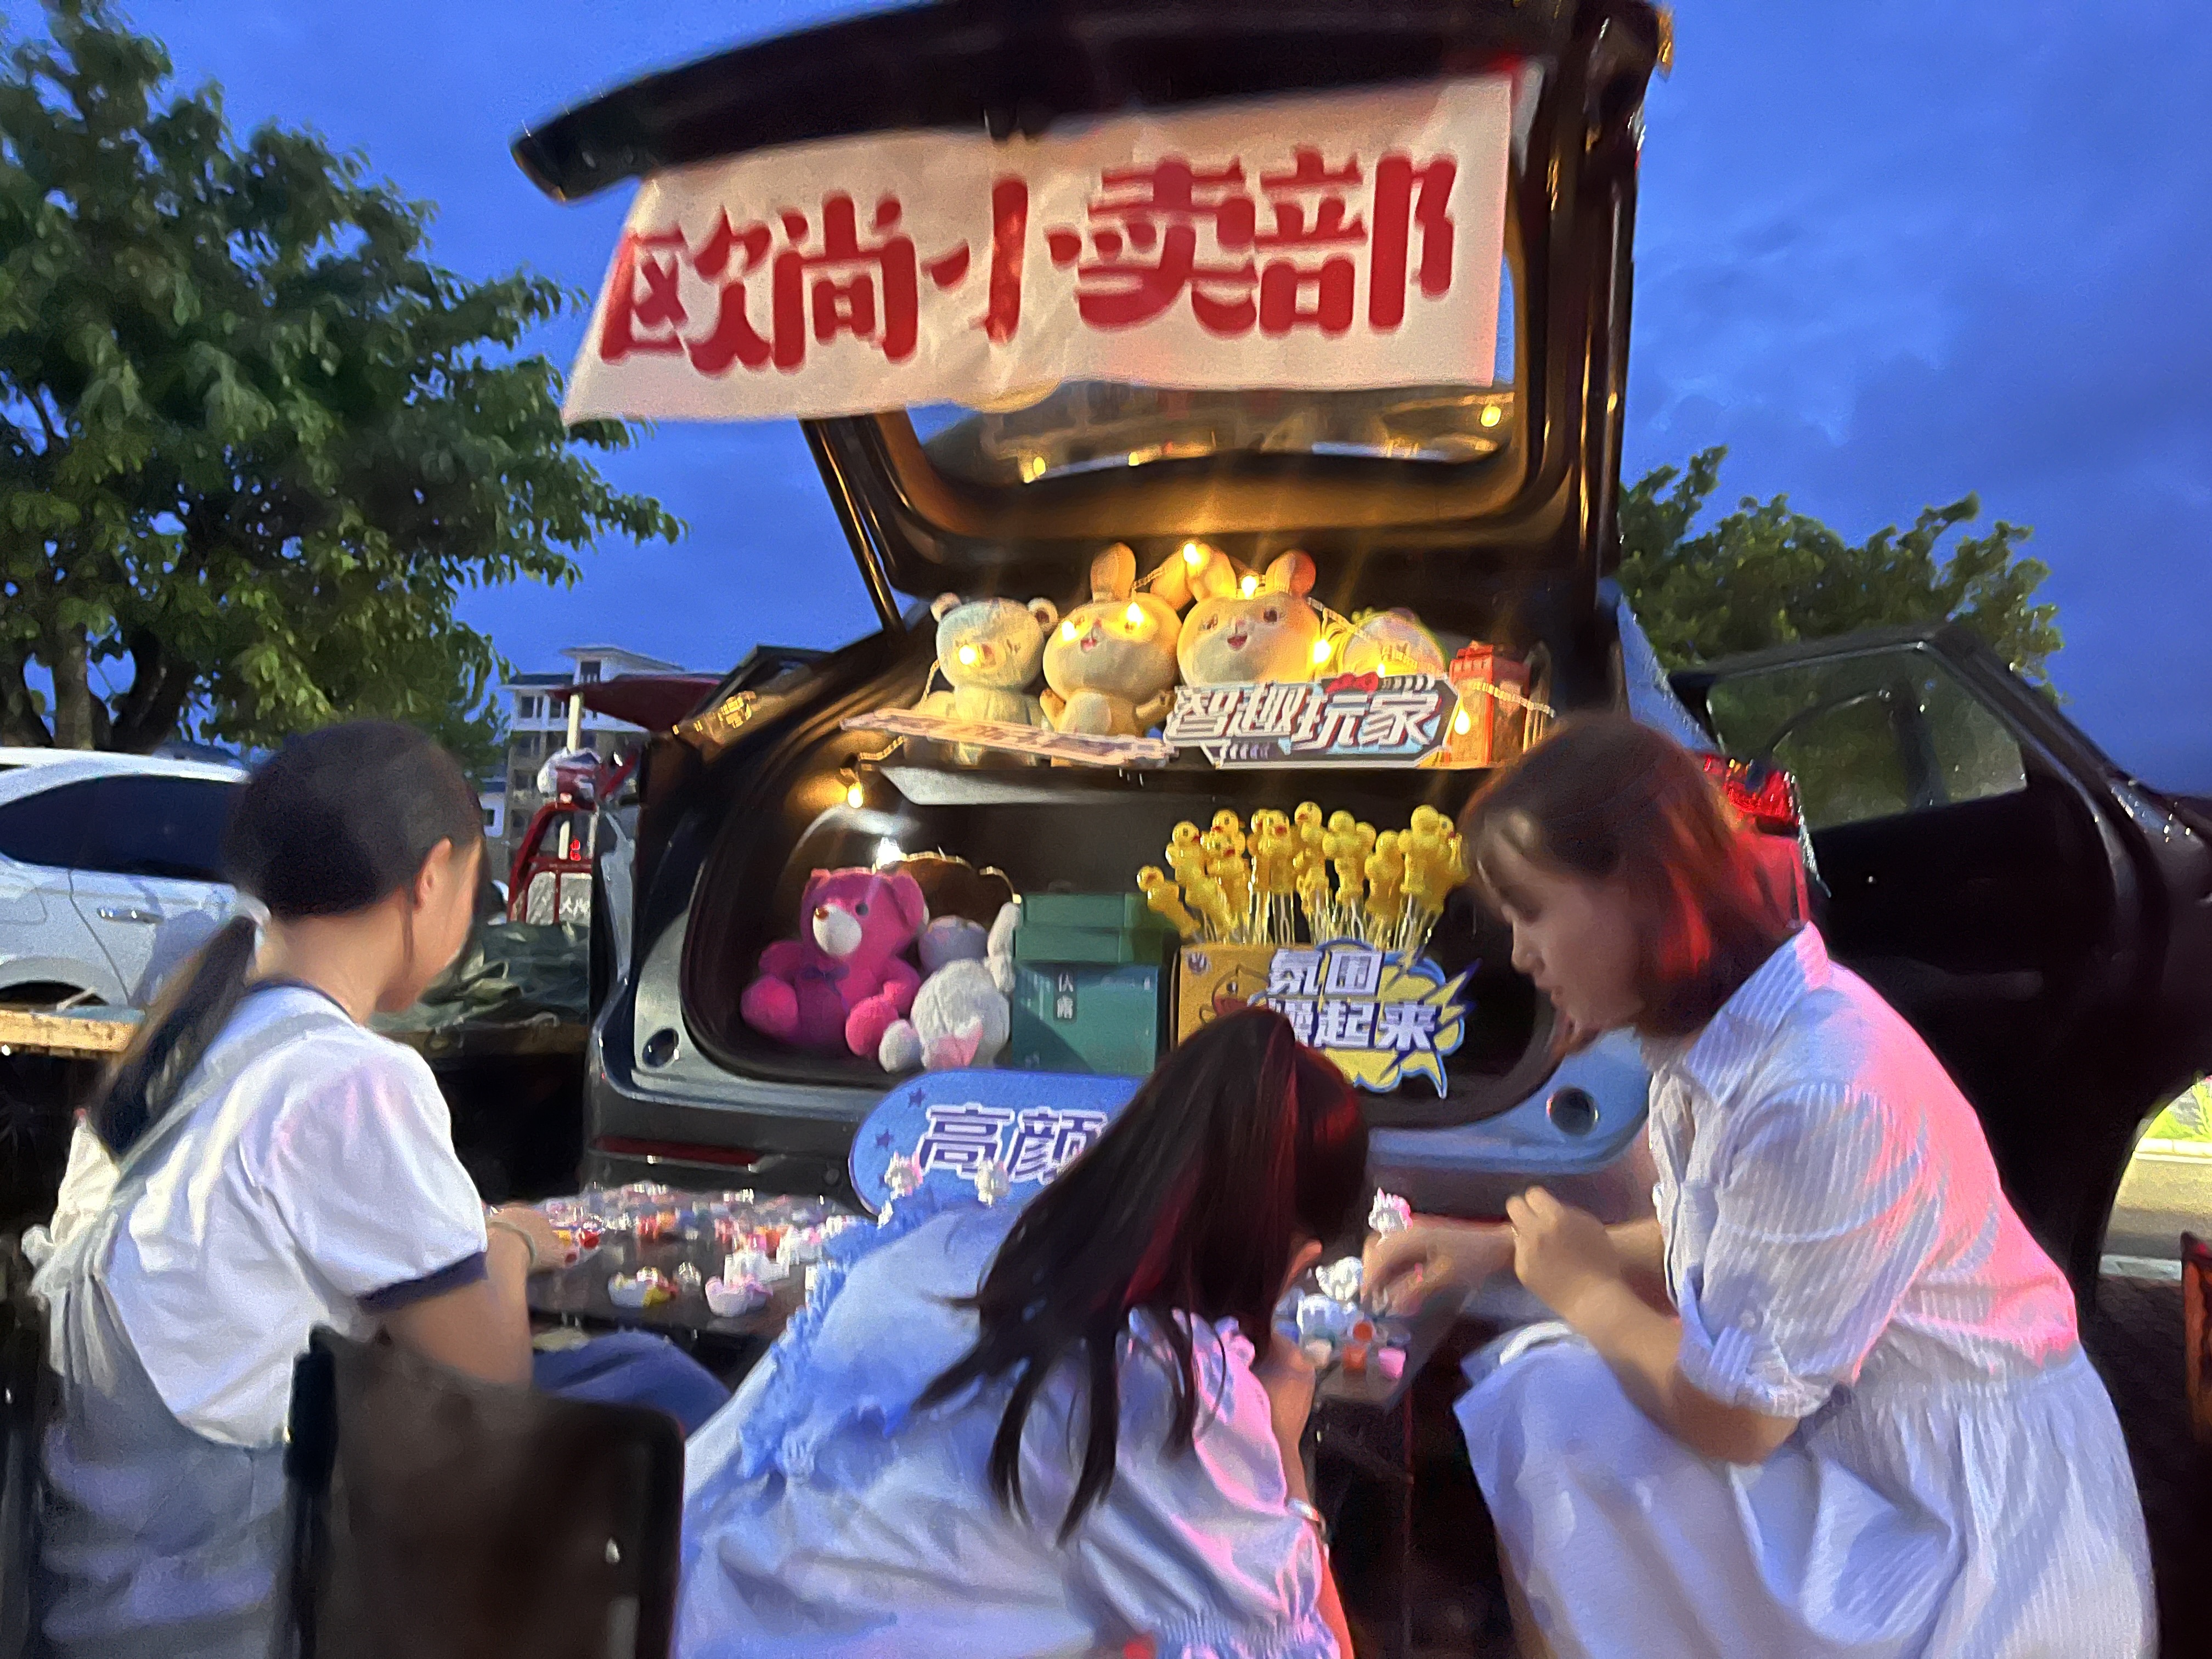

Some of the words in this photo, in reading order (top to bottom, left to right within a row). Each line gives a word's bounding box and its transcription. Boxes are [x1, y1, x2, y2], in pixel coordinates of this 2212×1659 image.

[598, 143, 1458, 377] 欧尚小卖部
[1163, 682, 1442, 751] 智趣玩家
